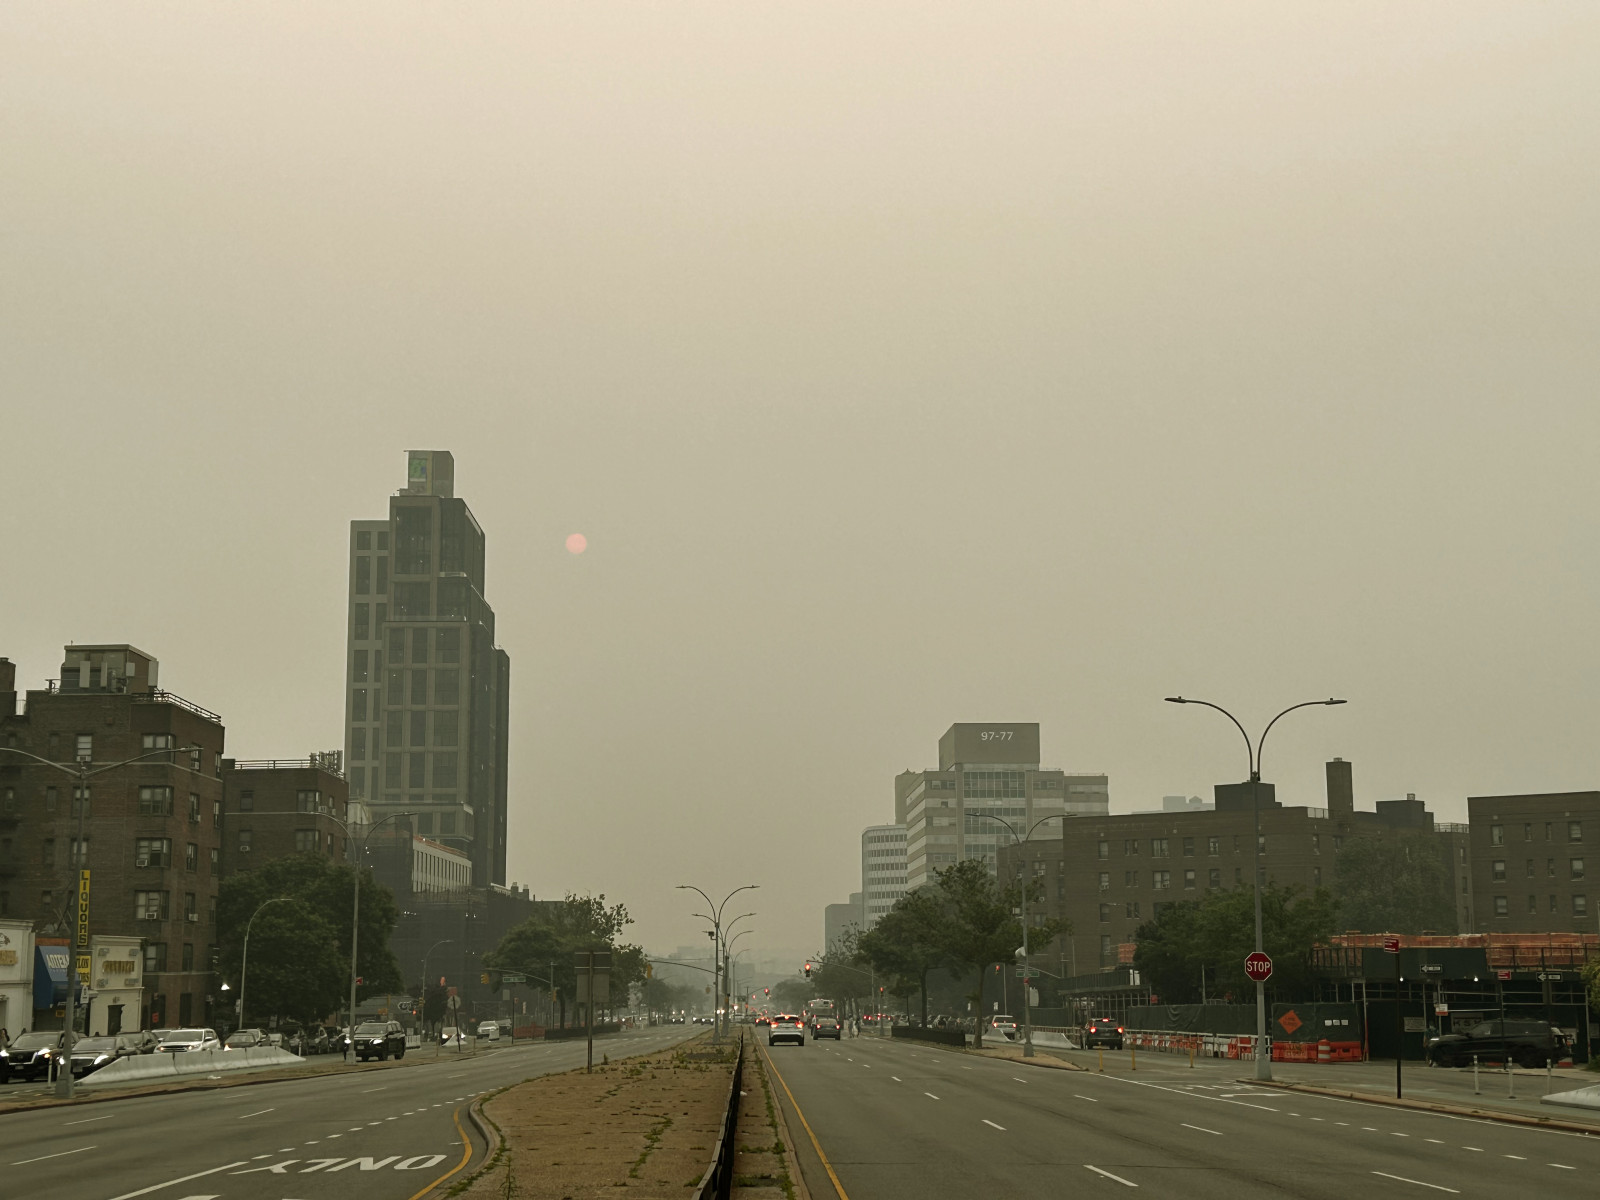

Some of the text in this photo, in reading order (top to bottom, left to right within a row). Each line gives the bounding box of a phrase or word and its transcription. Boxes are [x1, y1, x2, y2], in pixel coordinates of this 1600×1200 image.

[980, 731, 1014, 741] 97-77
[79, 871, 89, 944] LIQUORS
[1246, 961, 1271, 973] STOP
[227, 1154, 448, 1175] ONLY
